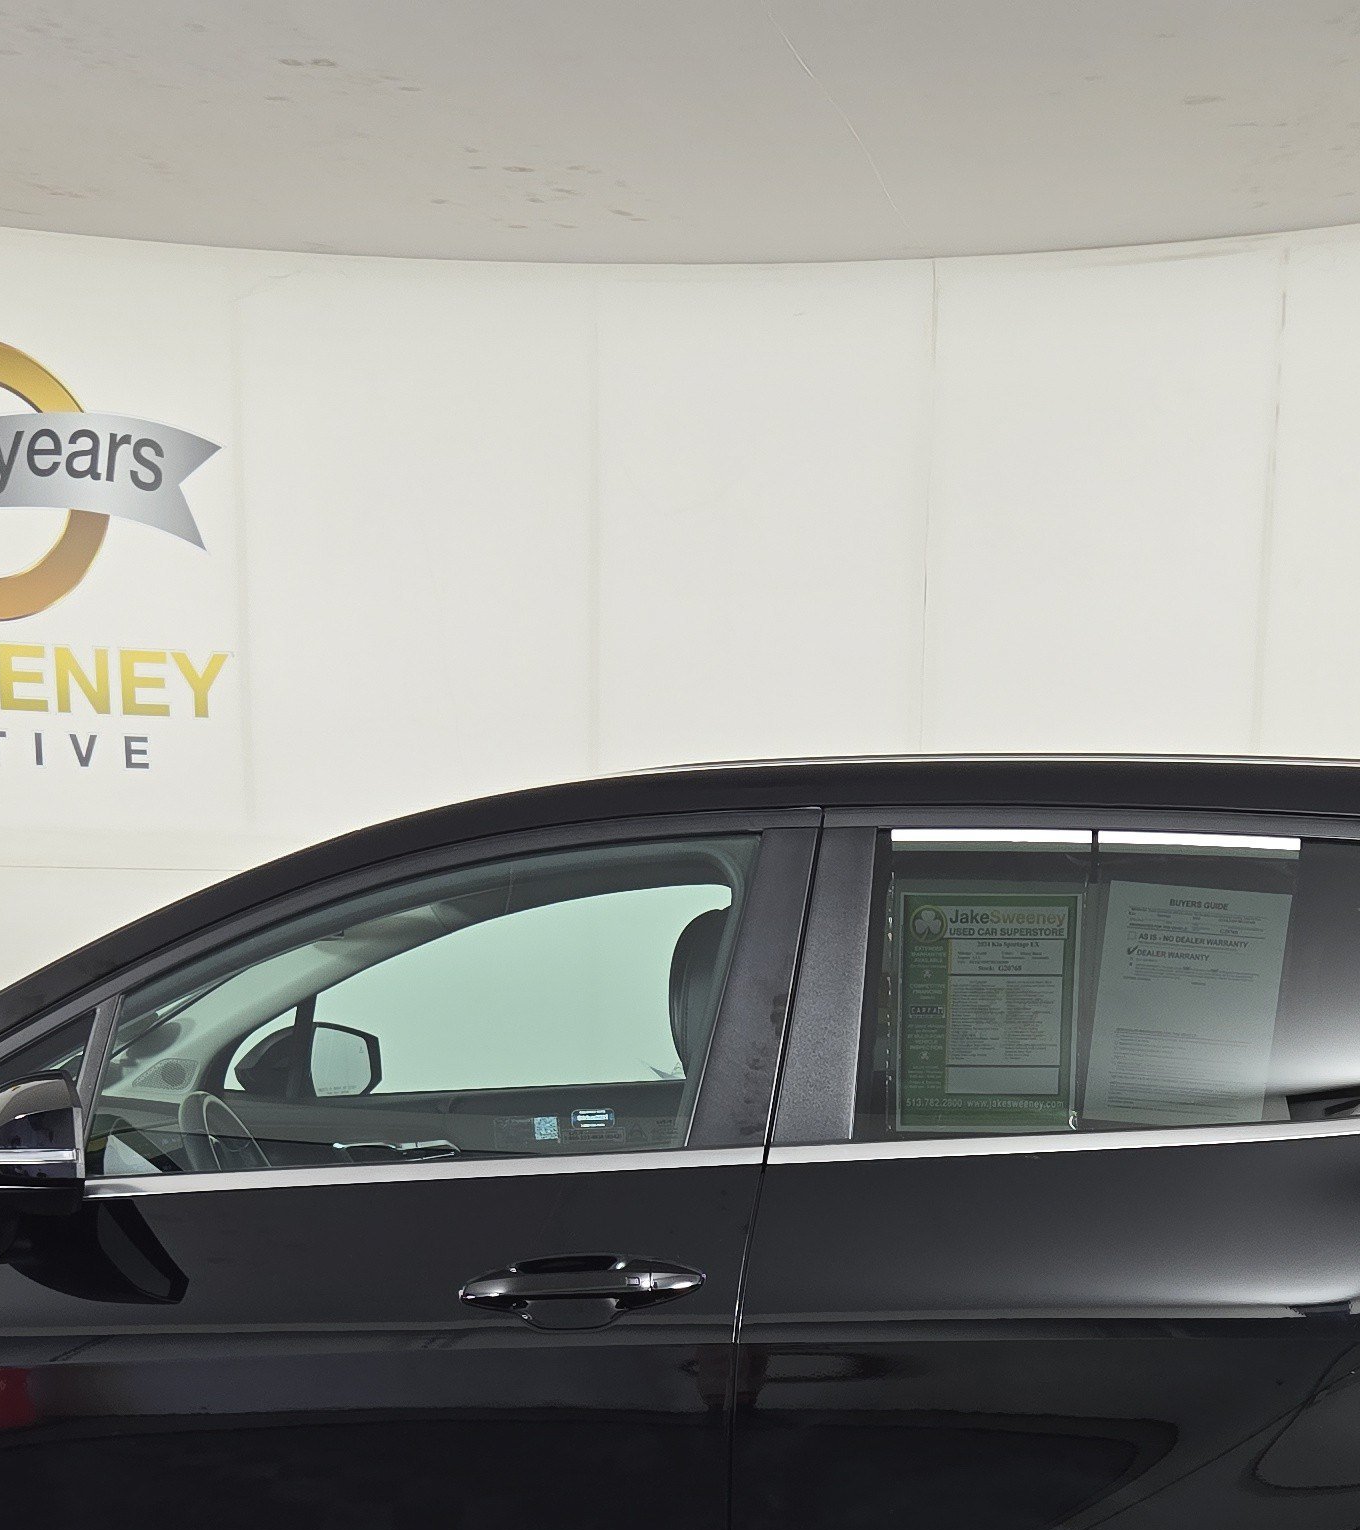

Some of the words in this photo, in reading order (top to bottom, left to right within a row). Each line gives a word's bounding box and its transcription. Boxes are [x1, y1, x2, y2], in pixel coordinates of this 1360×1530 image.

[1169, 898, 1202, 909] BUYERS
[1203, 902, 1229, 911] GUIDE
[949, 928, 976, 937] USED
[977, 928, 998, 937] CAR
[1000, 928, 1065, 937] SUPERSTORE
[1138, 933, 1149, 941] AS
[1150, 933, 1157, 941] IS
[1163, 934, 1174, 943] NO
[1175, 936, 1206, 946] DEALER
[1206, 938, 1250, 949] WARRANTY
[1136, 948, 1167, 958] DEALER
[1168, 951, 1210, 962] WARRANTY
